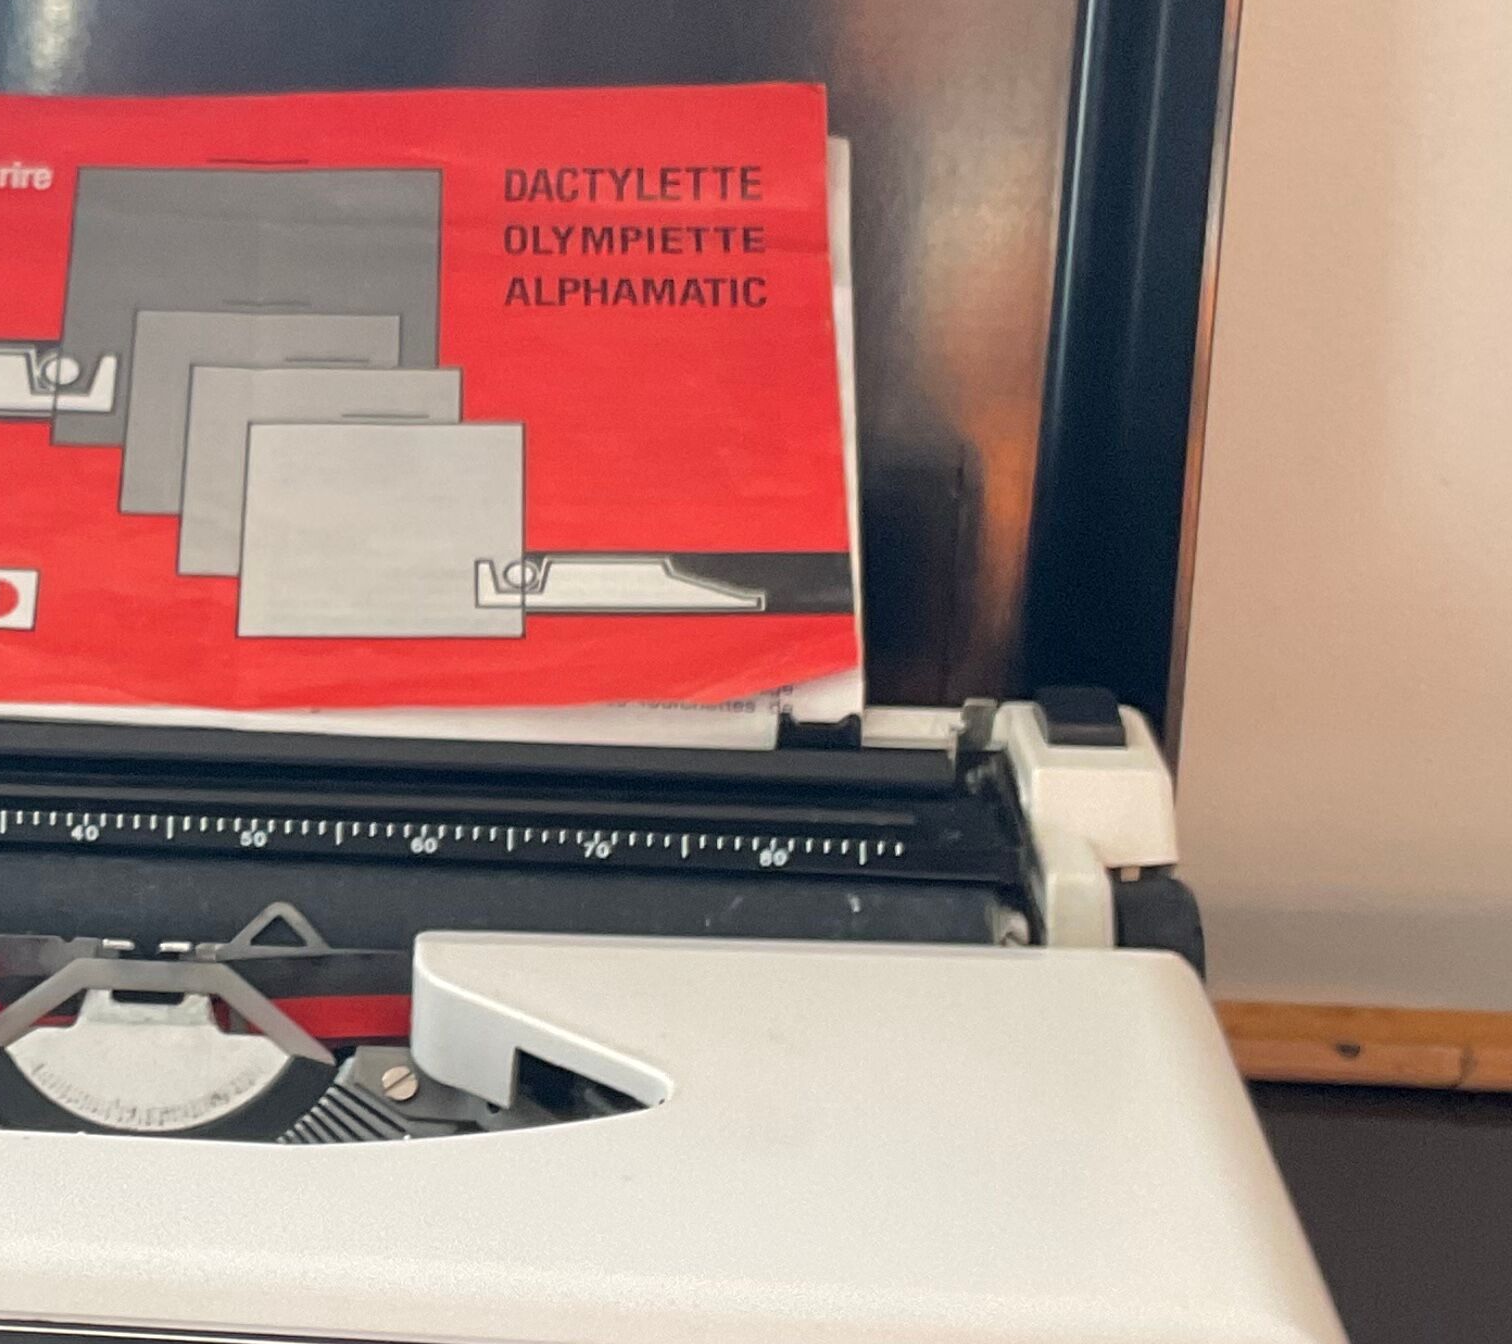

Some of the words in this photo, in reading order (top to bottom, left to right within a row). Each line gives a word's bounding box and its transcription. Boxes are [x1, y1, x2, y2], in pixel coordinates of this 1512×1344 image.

[504, 166, 763, 202] DACTYLETTE
[503, 224, 767, 255] OLYMPIETTE
[504, 276, 768, 308] ALPHAMATIC
[70, 824, 100, 842] 40
[410, 836, 438, 854] 60
[583, 840, 612, 859] 70
